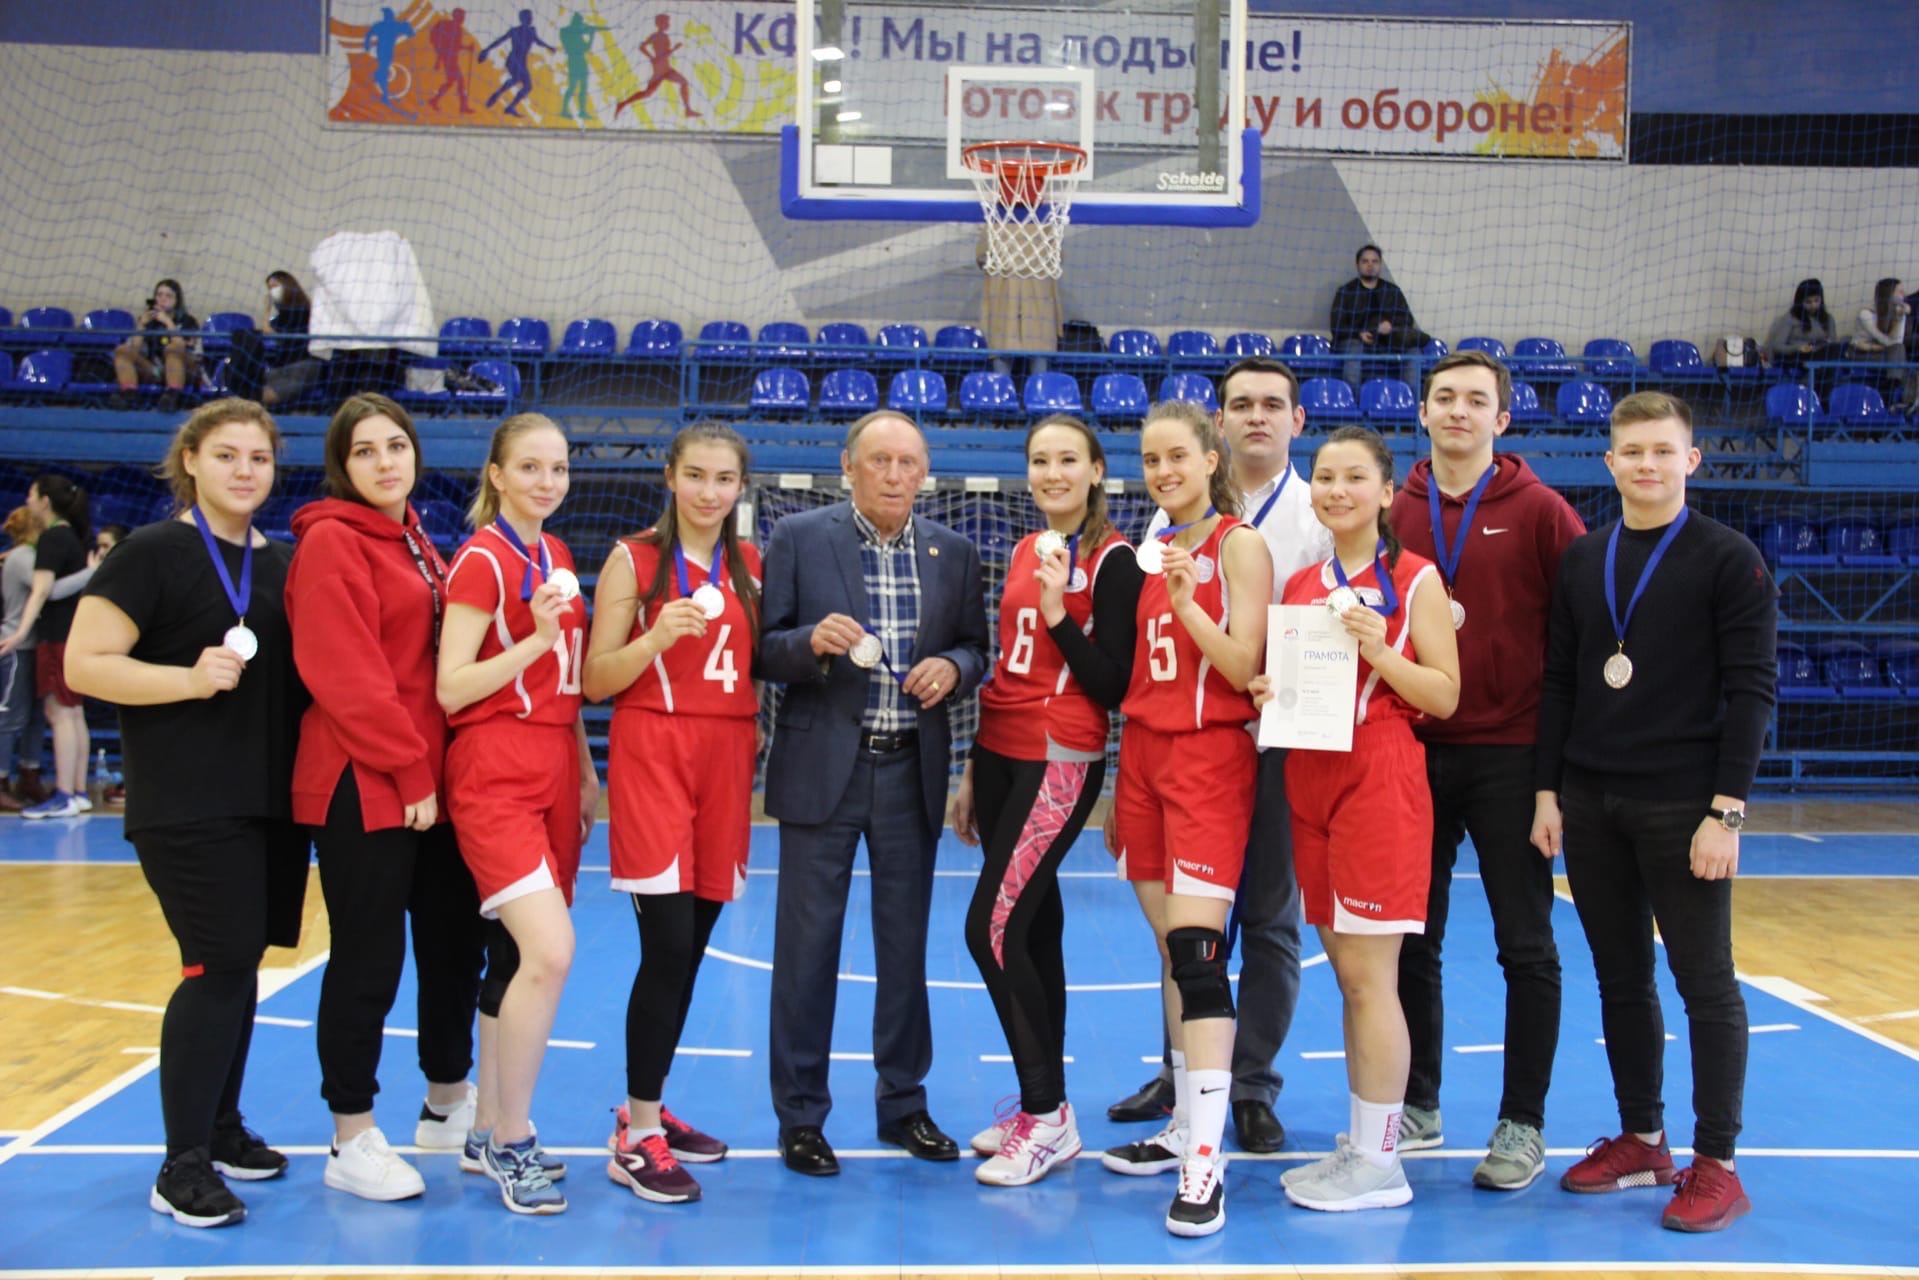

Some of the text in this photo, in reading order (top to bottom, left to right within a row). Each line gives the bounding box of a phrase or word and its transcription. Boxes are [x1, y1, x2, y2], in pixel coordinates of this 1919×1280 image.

[734, 12, 1302, 75] КФ! Мы на подъме!
[944, 73, 1574, 143] отов к тру и обороне!
[1156, 171, 1225, 191] Schelde
[703, 624, 738, 693] 4
[1007, 607, 1038, 674] 6
[1146, 612, 1178, 682] 15
[1303, 650, 1349, 662] ГРАМОТА
